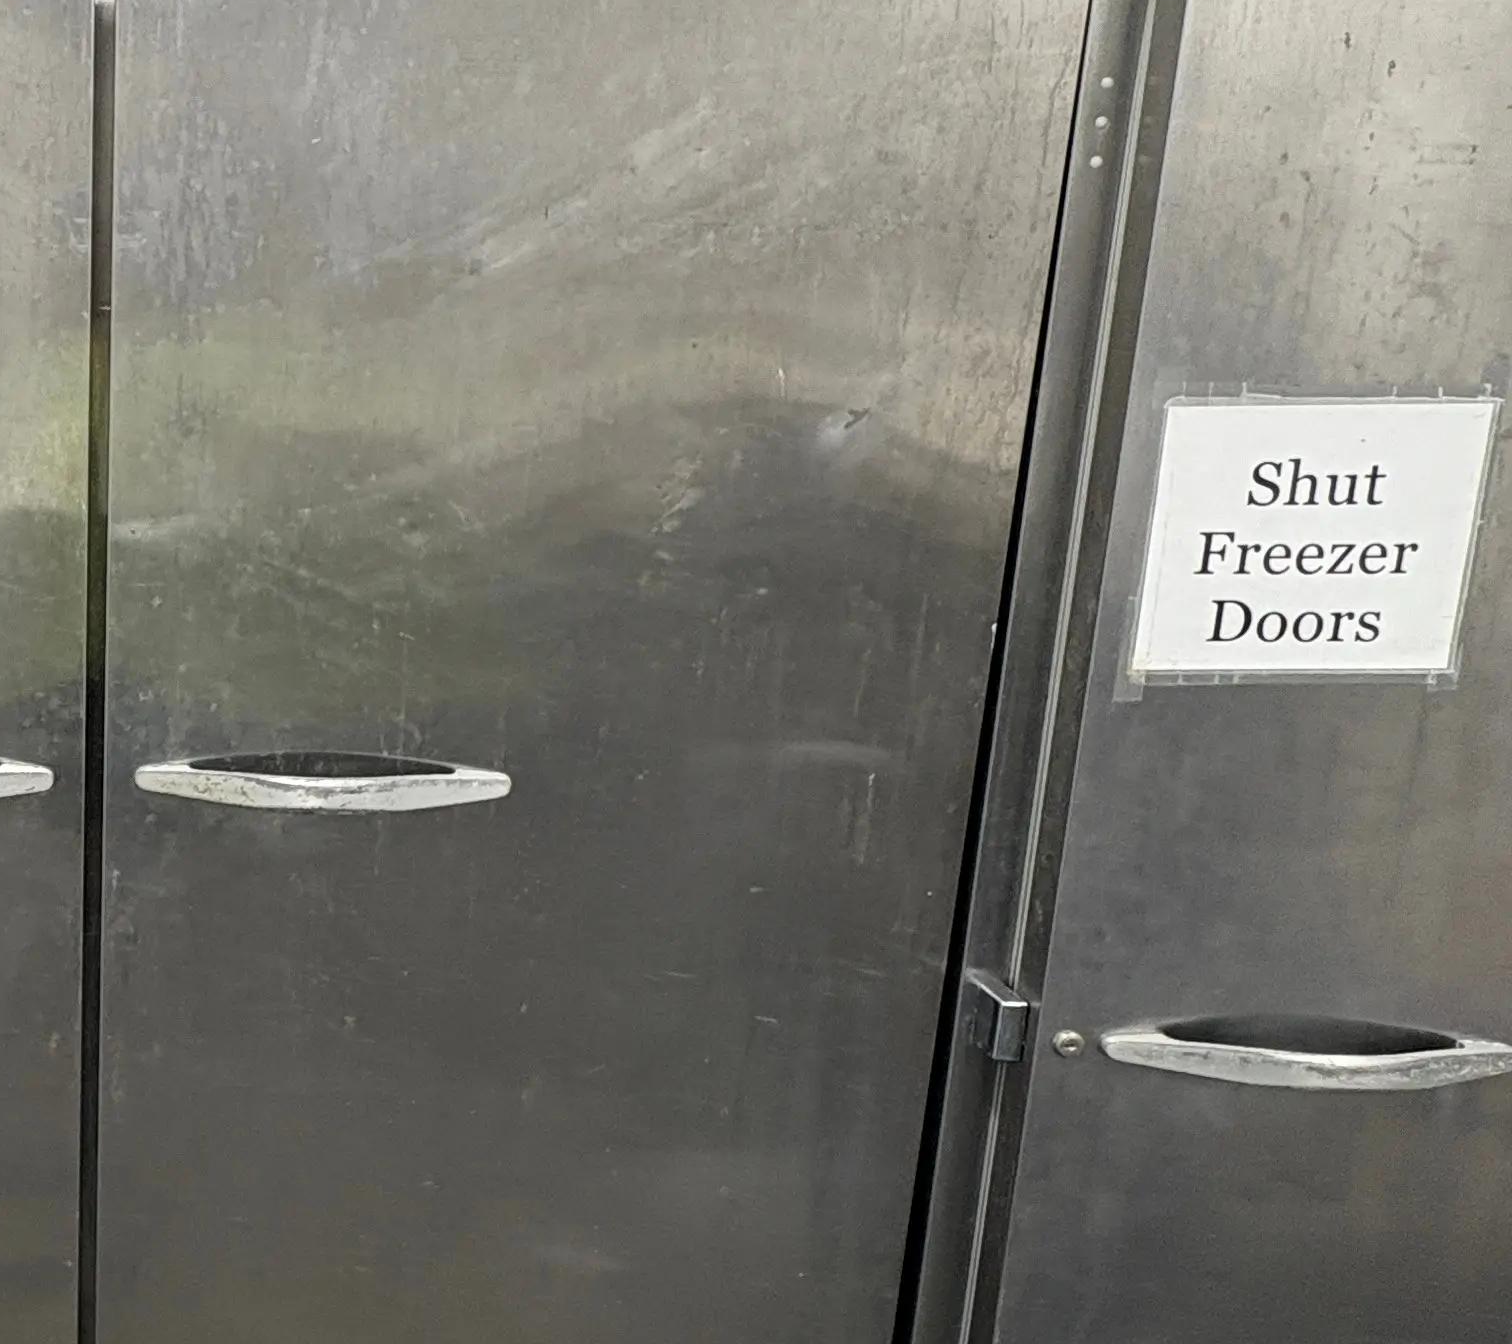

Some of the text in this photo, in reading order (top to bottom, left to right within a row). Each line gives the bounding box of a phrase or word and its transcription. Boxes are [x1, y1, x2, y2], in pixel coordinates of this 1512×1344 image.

[1246, 458, 1388, 507] Shut
[1193, 531, 1419, 576] Freezer
[1205, 599, 1382, 643] Doors
